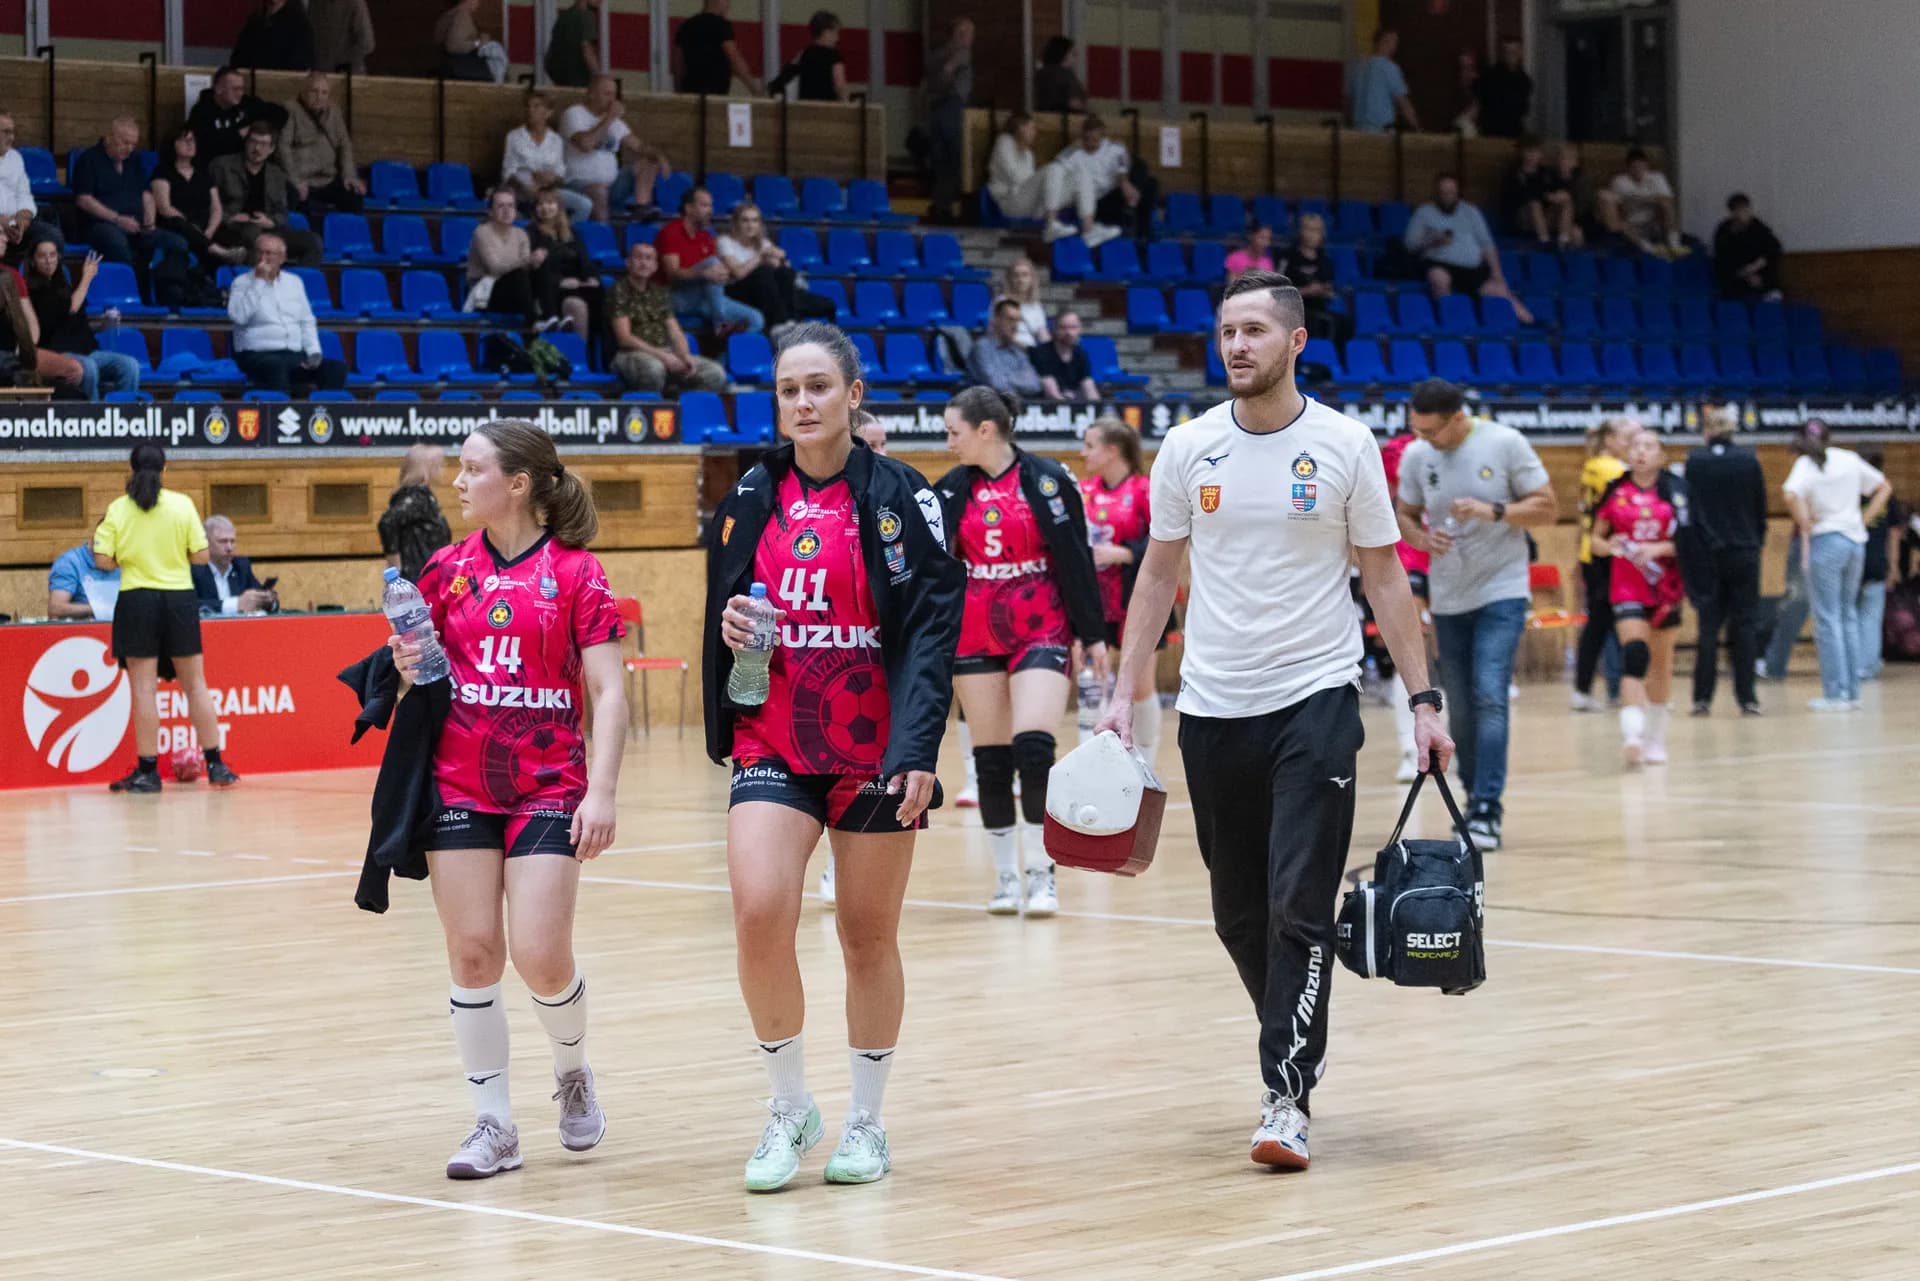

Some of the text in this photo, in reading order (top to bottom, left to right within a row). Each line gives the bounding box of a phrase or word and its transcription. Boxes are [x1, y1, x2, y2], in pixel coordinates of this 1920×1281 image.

[984, 529, 1003, 557] 5
[1633, 519, 1661, 541] 22
[973, 558, 1047, 580] SUZUKI
[777, 567, 829, 611] 41
[775, 624, 882, 648] UZUK
[475, 636, 522, 673] 14
[156, 685, 295, 718] ENRALNA
[460, 683, 572, 709] SUZUKI
[157, 723, 230, 753] OBIT
[744, 767, 787, 780] Kielce
[1406, 931, 1462, 949] SELECT
[1296, 945, 1323, 1026] MIZUNO
